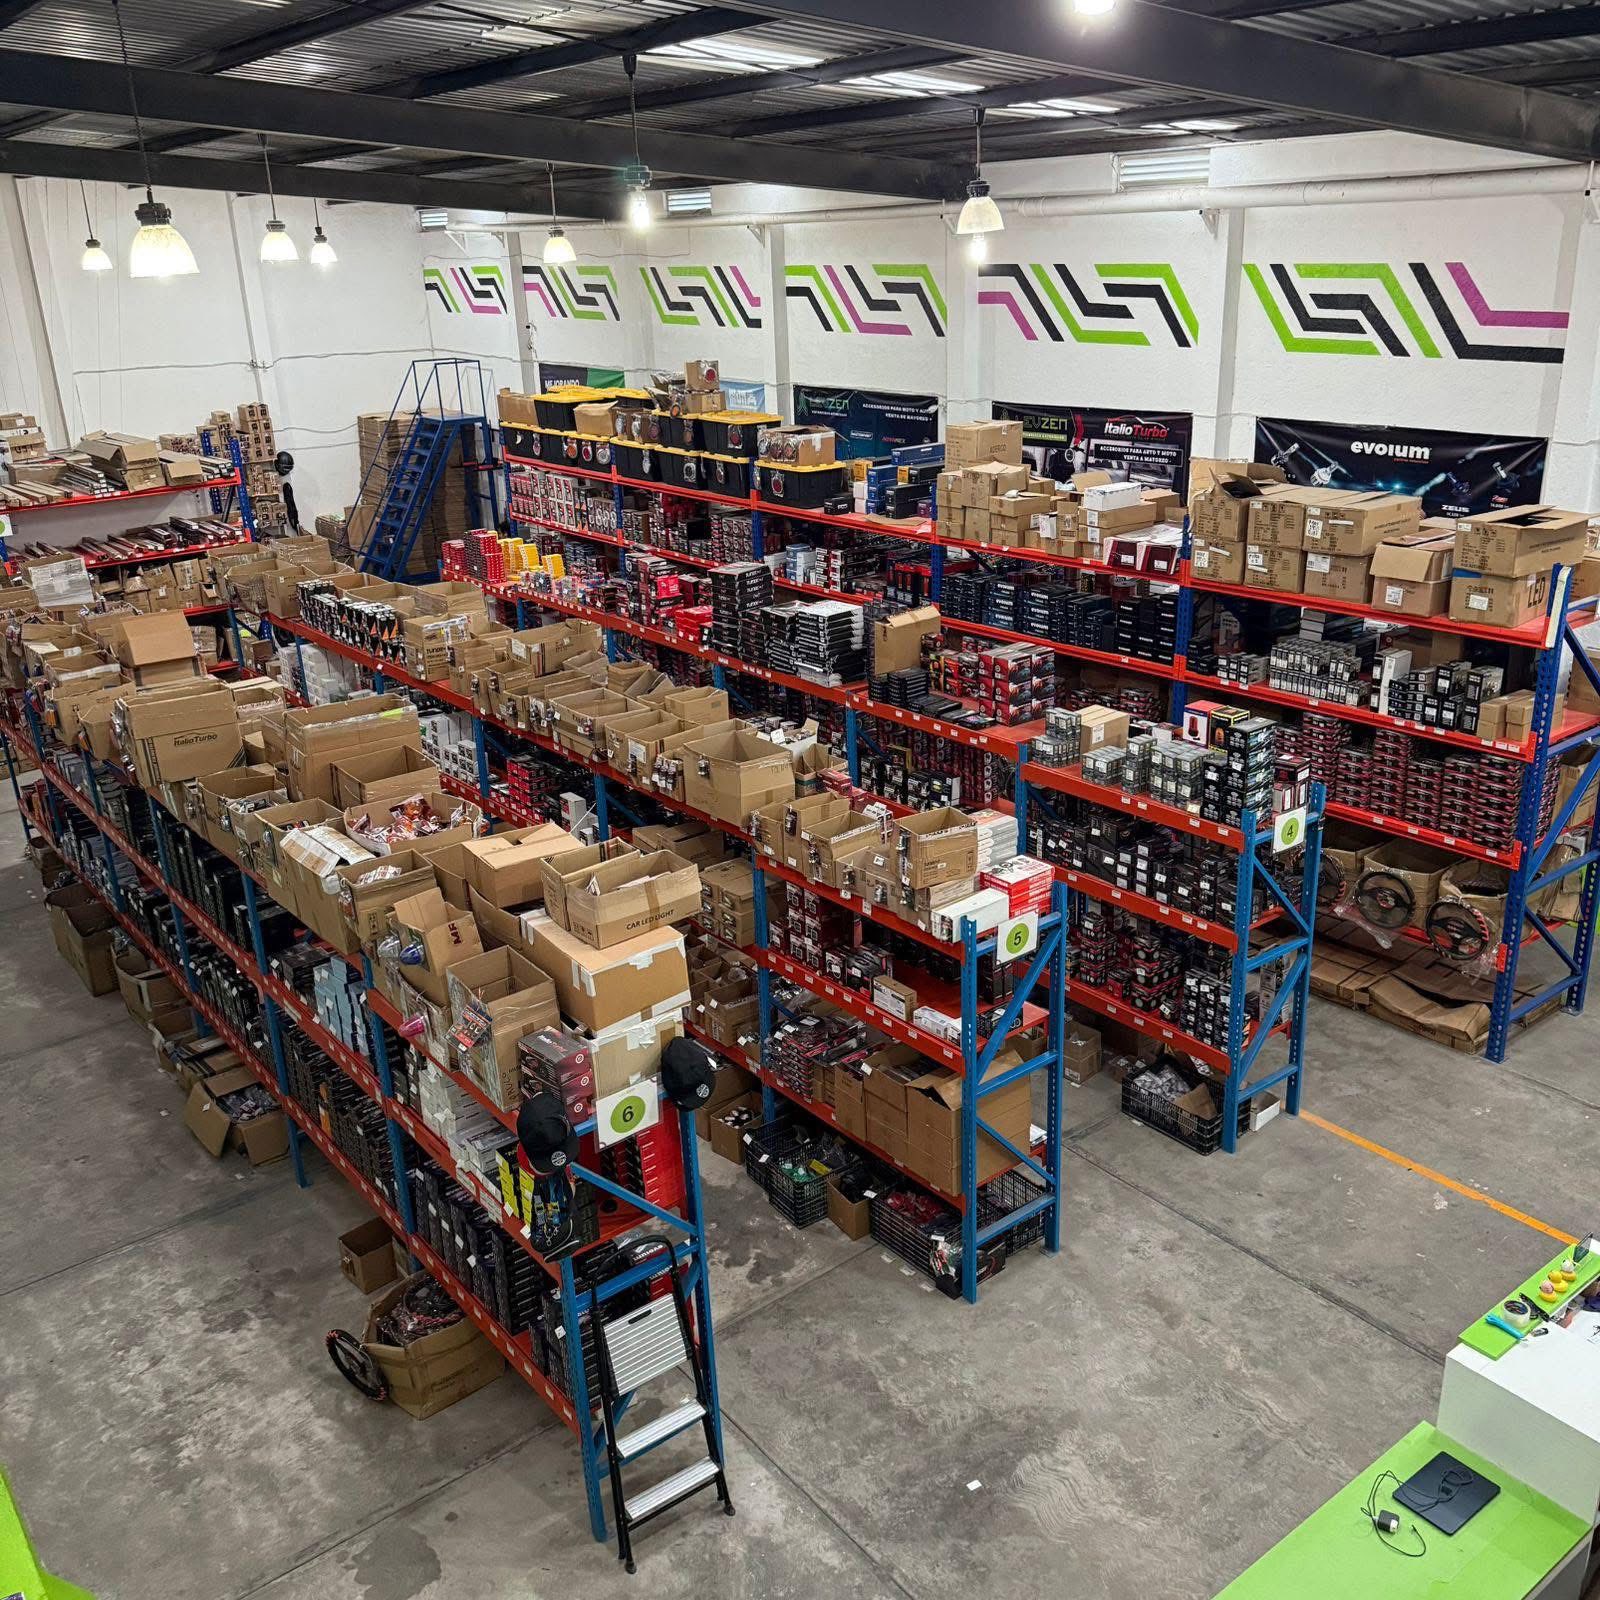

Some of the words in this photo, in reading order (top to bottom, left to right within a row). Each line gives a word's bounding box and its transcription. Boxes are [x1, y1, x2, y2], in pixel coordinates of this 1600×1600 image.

[1441, 504, 1470, 514] ZEUS
[1286, 824, 1294, 838] 4
[626, 920, 641, 930] CAR
[641, 916, 655, 925] LED
[654, 909, 674, 920] LIGHT
[1013, 930, 1022, 946] 5
[622, 1105, 634, 1123] 6
